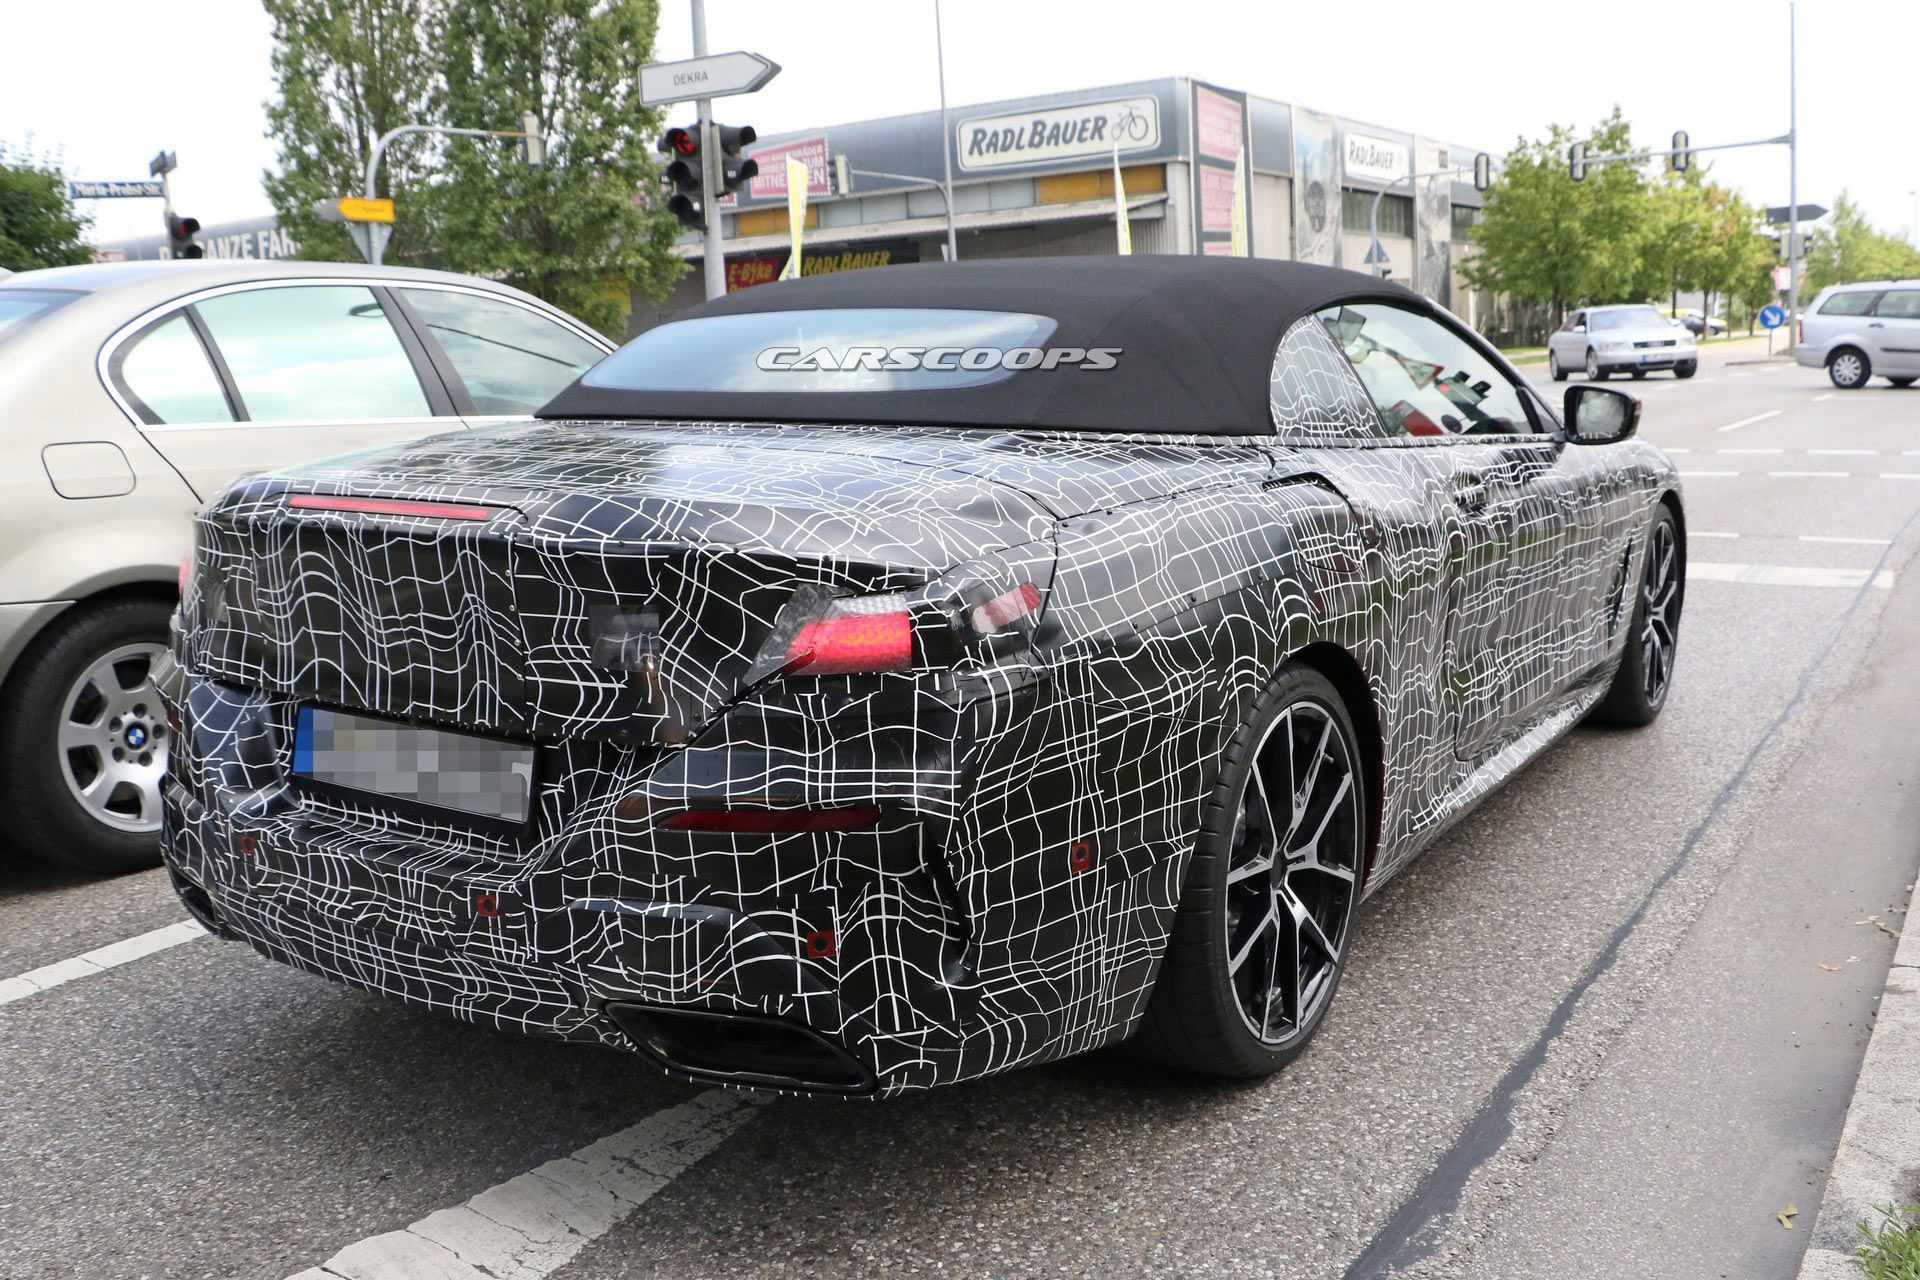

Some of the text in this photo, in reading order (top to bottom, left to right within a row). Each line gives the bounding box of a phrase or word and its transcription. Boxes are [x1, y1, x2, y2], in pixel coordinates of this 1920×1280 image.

[672, 70, 709, 86] DEKRA
[968, 115, 1108, 157] RADLBAUER
[753, 167, 825, 189] MITNEEN
